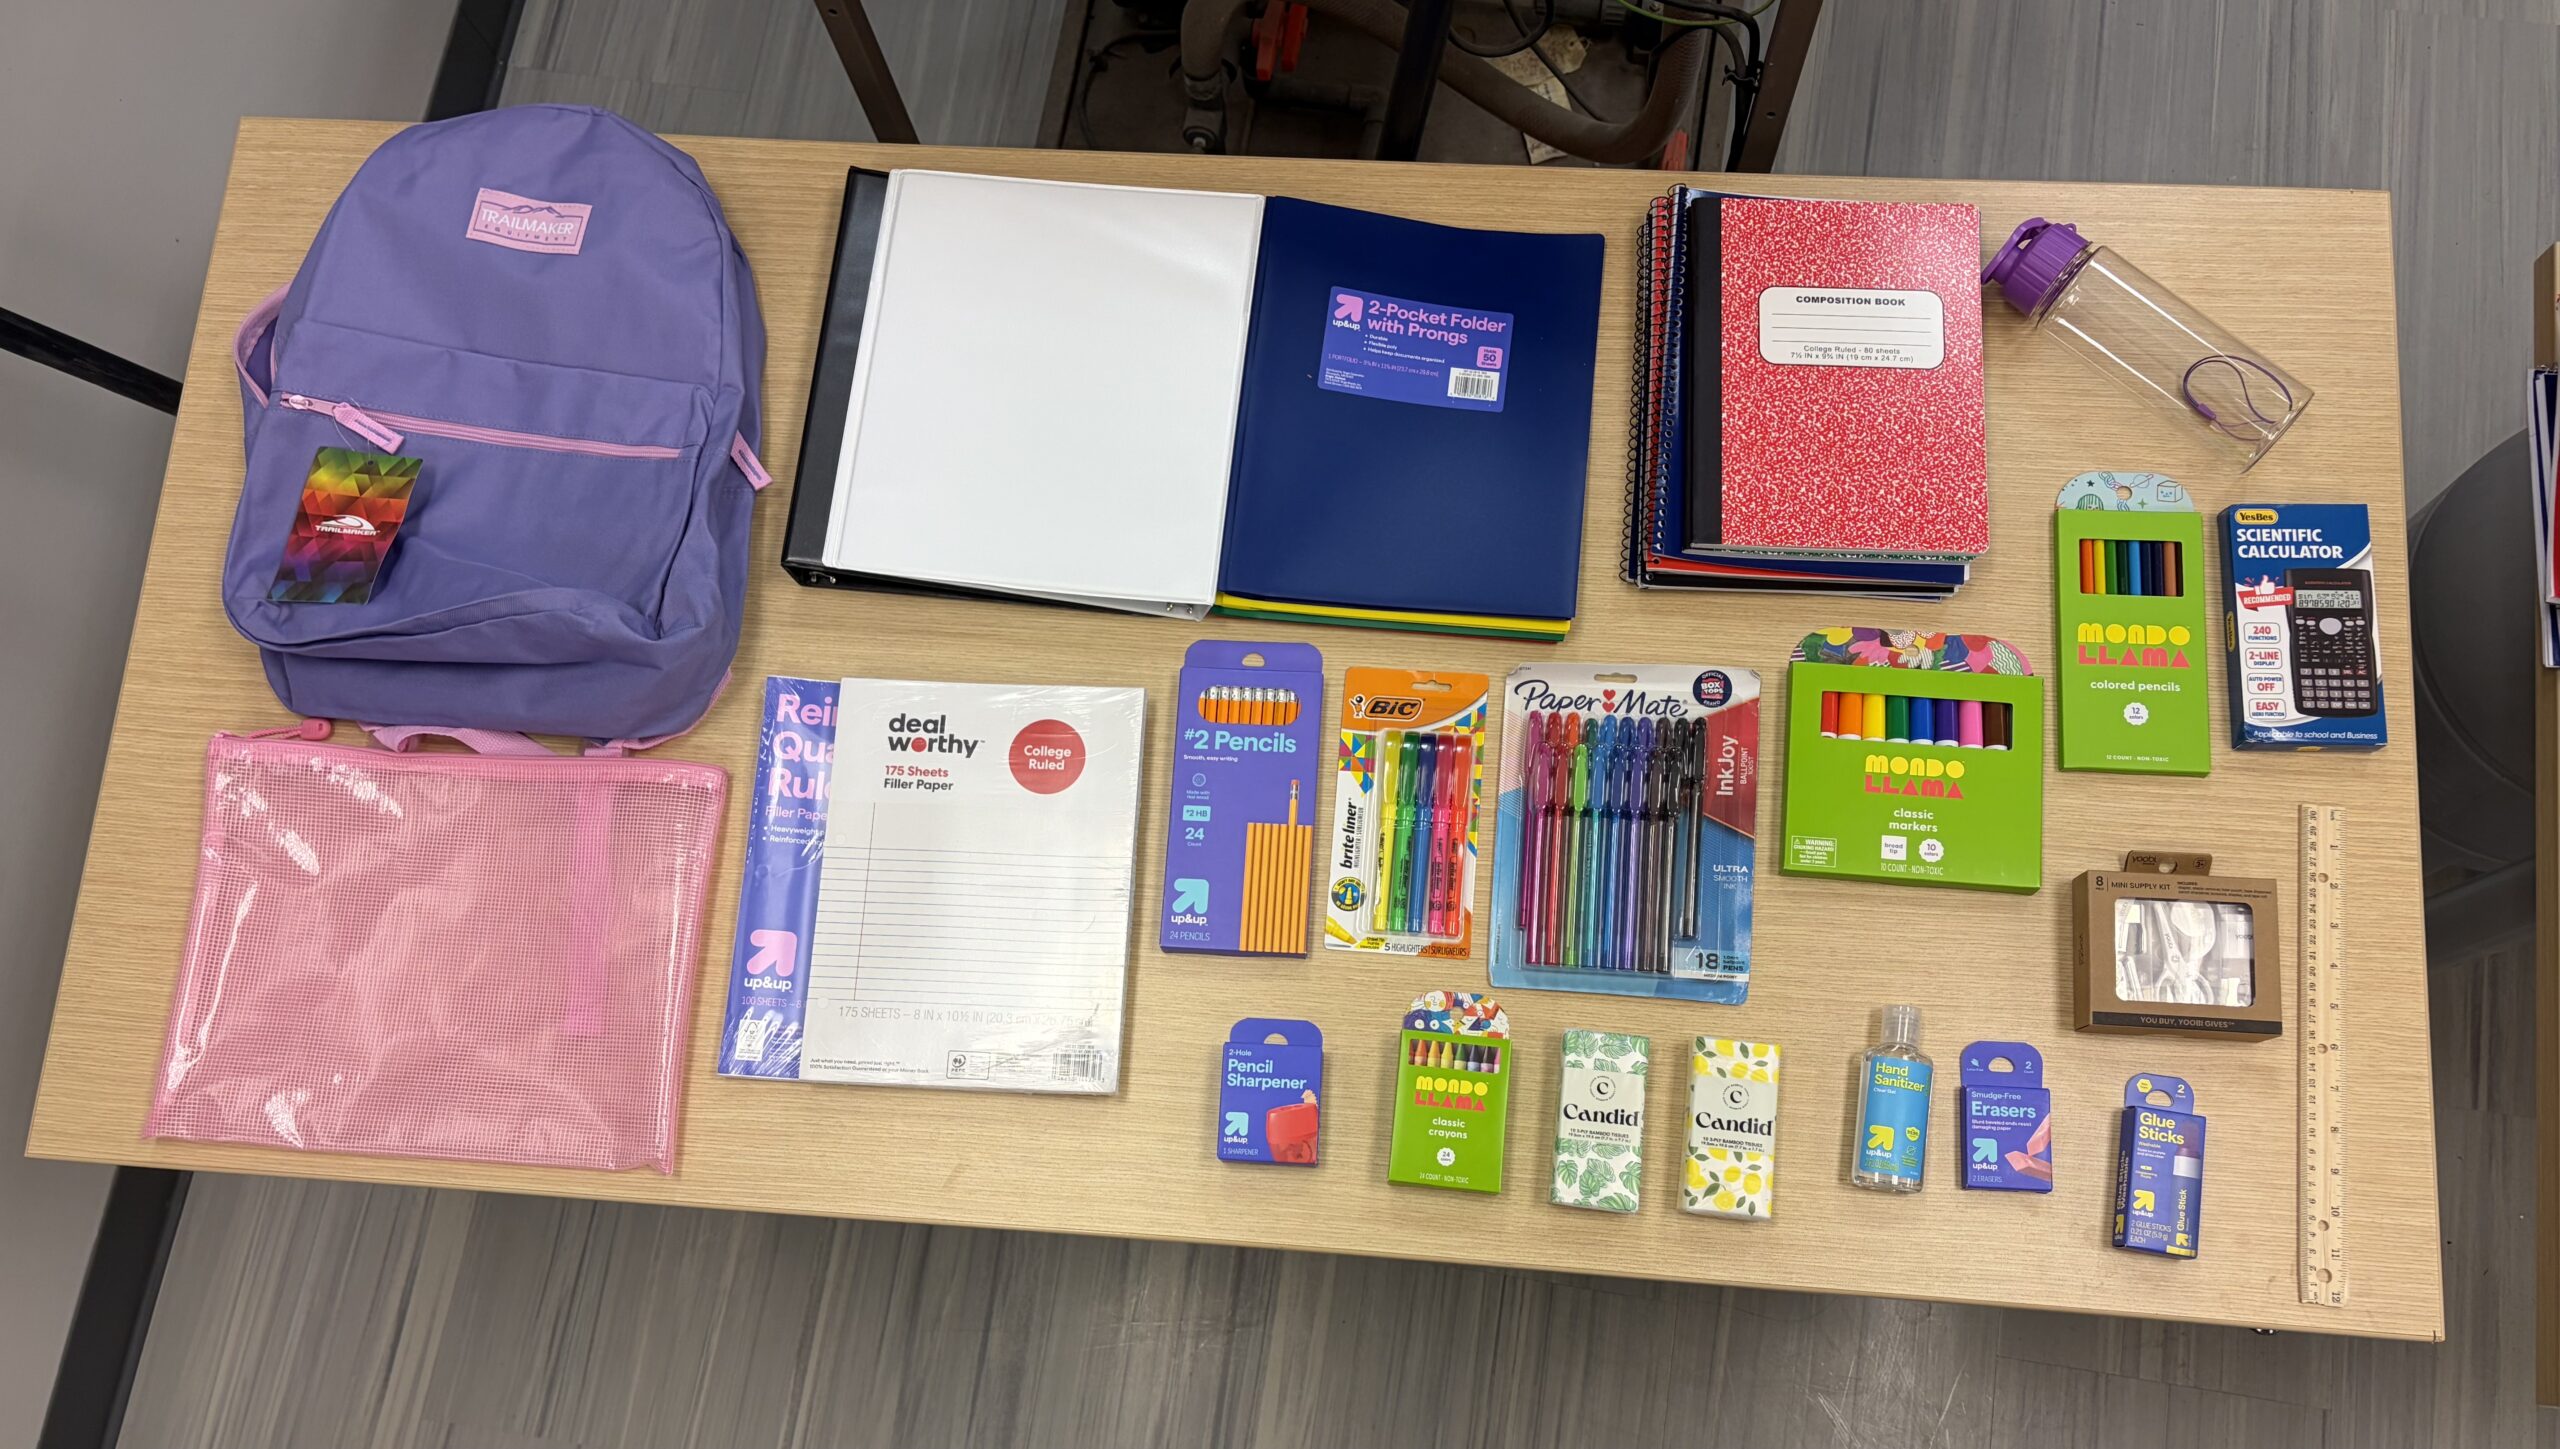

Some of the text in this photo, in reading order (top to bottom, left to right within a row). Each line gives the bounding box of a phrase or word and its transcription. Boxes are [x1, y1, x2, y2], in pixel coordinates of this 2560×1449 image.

[482, 209, 574, 234] TRAILMAKER
[484, 224, 567, 241] EQUIPMENT
[1796, 296, 1906, 306] COMPOSITION BOOK
[1368, 300, 1506, 332] 2-Pocket Folder
[1333, 319, 1360, 330] up&up
[1368, 317, 1468, 346] with Prongs
[1804, 345, 1832, 353] College
[1484, 354, 1496, 362] 50
[2240, 513, 2273, 521] YesBes
[315, 525, 377, 536] TRAILMAKER
[2237, 529, 2323, 542] SCIENTIFIC
[2238, 546, 2343, 559] CALCULATOR
[2244, 594, 2291, 604] RECOMMENDED
[2078, 623, 2190, 646] MONDO
[2253, 626, 2271, 634] 240
[2078, 644, 2191, 668] LLAMA
[2249, 651, 2279, 660] 2-LINE
[2090, 680, 2181, 692] colored pencils
[2257, 683, 2275, 691] OFF
[1514, 679, 1689, 717] Paper Mate
[2256, 702, 2279, 710] EASY
[889, 713, 946, 734] deal
[888, 734, 979, 758] worthy
[1184, 728, 1297, 753] #2 Pencils
[1024, 745, 1071, 759] College
[1029, 759, 1065, 770] Ruled
[1716, 735, 1738, 795] InkJoy
[1740, 747, 1748, 784] BALLPOINT
[1865, 754, 1965, 778] MONDO
[885, 765, 949, 777] 175 Sheets
[884, 778, 954, 792] Filler Paper
[1864, 775, 1964, 800] LLAMA
[765, 805, 795, 818] Filler
[1893, 808, 1934, 820] classic
[1889, 821, 1938, 832] markers
[1185, 828, 1204, 840] 24
[2132, 855, 2157, 863] yoobi
[1713, 864, 1748, 873] ULTRA
[1881, 863, 1944, 875] 10 COUNT NON-TOXIC
[2096, 876, 2103, 886] 8
[2130, 882, 2157, 890] SUPPLY
[1171, 914, 1207, 925] up&up
[1170, 931, 1210, 941] 24 PENCILS
[1385, 943, 1390, 951] 5
[1696, 953, 1718, 969] 18
[744, 976, 792, 992] up&up
[757, 997, 787, 1007] SHEETS
[840, 1006, 858, 1017] 175
[861, 1007, 900, 1019] SHEETS
[914, 1009, 920, 1020] 8
[924, 1010, 934, 1020] IN
[973, 1012, 983, 1022] IN
[2141, 1016, 2228, 1028] YOU BUY, YOOBI GIVES
[1228, 1059, 1273, 1073] Pencil
[1876, 1062, 1908, 1076] Hand
[1227, 1073, 1307, 1090] Sharpener
[1416, 1076, 1488, 1096] MONDO
[1875, 1074, 1925, 1092] Sanitizer
[1597, 1082, 1608, 1094] C
[2177, 1084, 2185, 1093] 2
[1415, 1091, 1486, 1112] LLAMA
[1730, 1090, 1742, 1103] C
[1972, 1091, 2021, 1100] Smudge-Free
[1563, 1103, 1640, 1127] Candid
[1972, 1101, 2036, 1118] Erasers
[1433, 1117, 1465, 1128] classic
[1695, 1112, 1773, 1136] Candid
[2140, 1112, 2176, 1129] Glue
[1429, 1128, 1467, 1139] crayons
[2139, 1126, 2184, 1144] Sticks
[1224, 1136, 1248, 1144] up&up
[1866, 1149, 1891, 1158] up&up
[1973, 1163, 1998, 1171] up&up
[1444, 1175, 1469, 1184] NON-TOXIC
[2132, 1210, 2153, 1218] up&up
[2177, 1189, 2187, 1231] Glue Stick
[2331, 1206, 2340, 1217] 10
[2332, 1249, 2340, 1257] 11
[2332, 1292, 2340, 1303] 12
